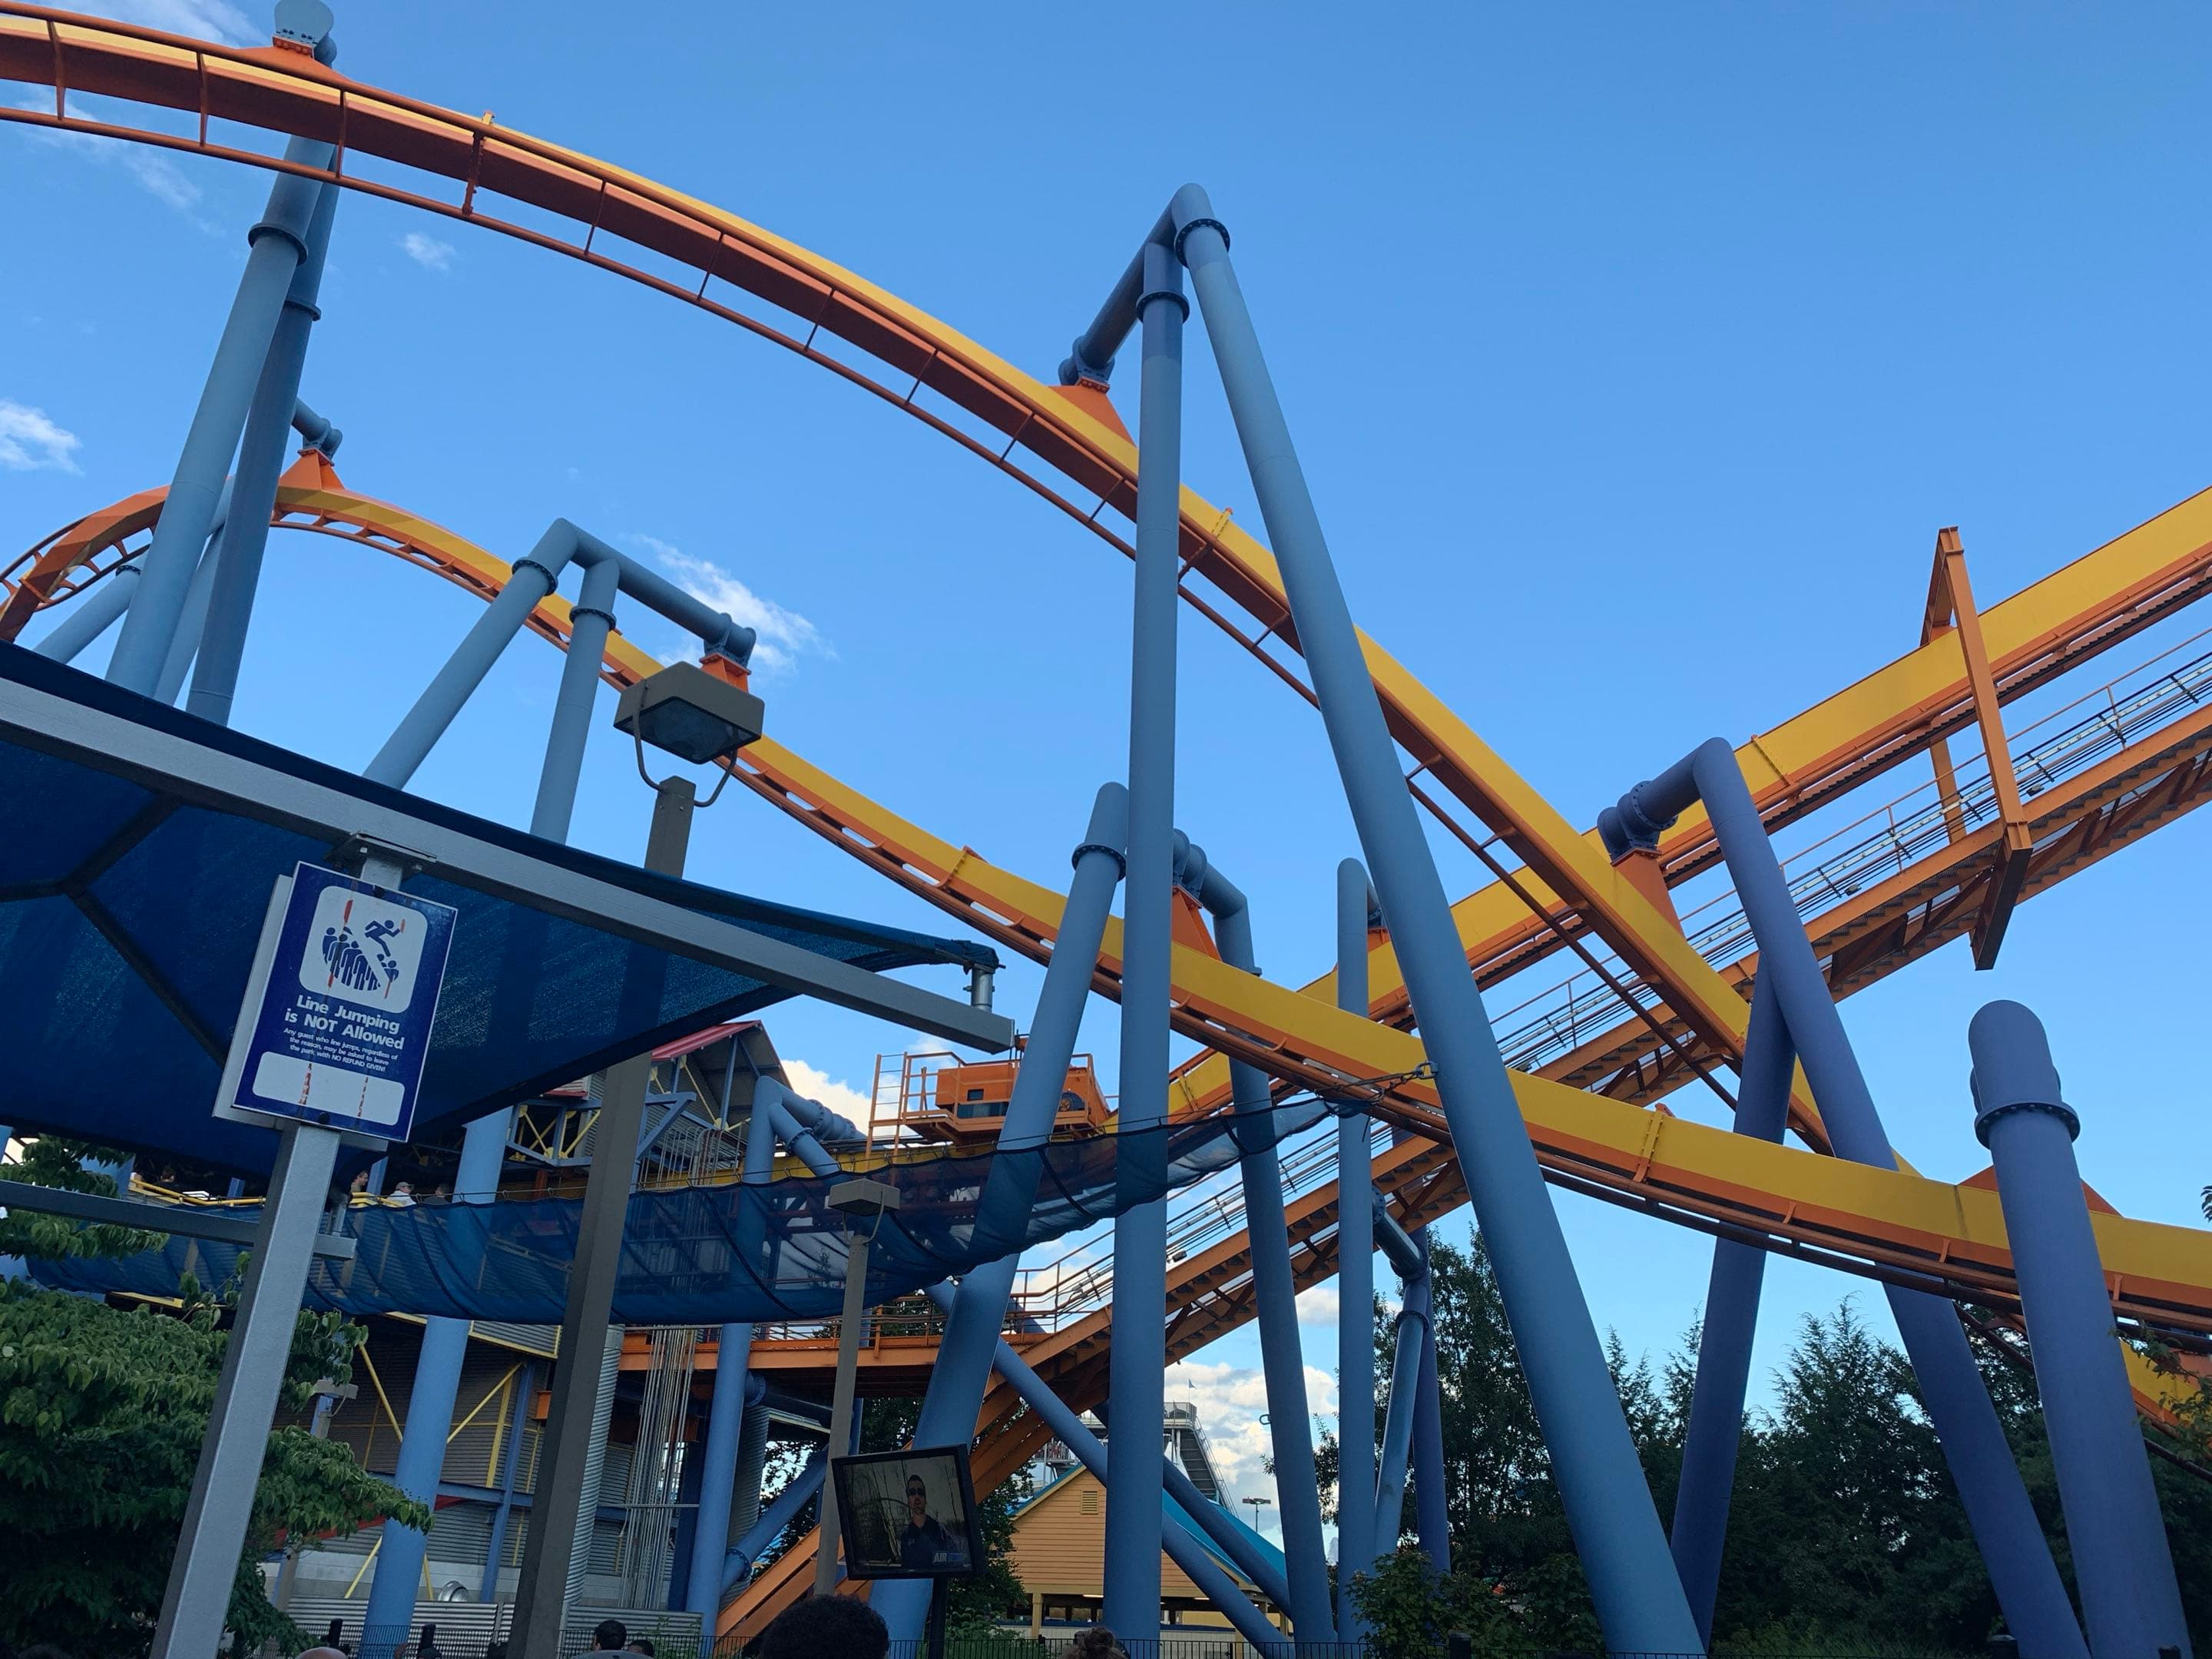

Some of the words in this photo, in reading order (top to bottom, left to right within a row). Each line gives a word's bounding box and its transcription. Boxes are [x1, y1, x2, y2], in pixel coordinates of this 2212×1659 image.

[284, 1008, 298, 1023] is
[304, 1014, 338, 1033] NOT
[342, 1025, 406, 1050] Allowed
[296, 995, 329, 1014] Line
[334, 1005, 400, 1035] Jumping
[283, 1028, 296, 1036] Any
[297, 1031, 314, 1041] guest
[316, 1035, 329, 1044] who
[330, 1038, 341, 1047] line
[290, 1036, 300, 1045] the
[323, 1045, 337, 1055] may
[347, 1051, 365, 1060] asked
[373, 1057, 389, 1065] leave
[290, 1044, 300, 1052] the
[316, 1051, 331, 1059] with
[342, 1057, 365, 1068] REFUND
